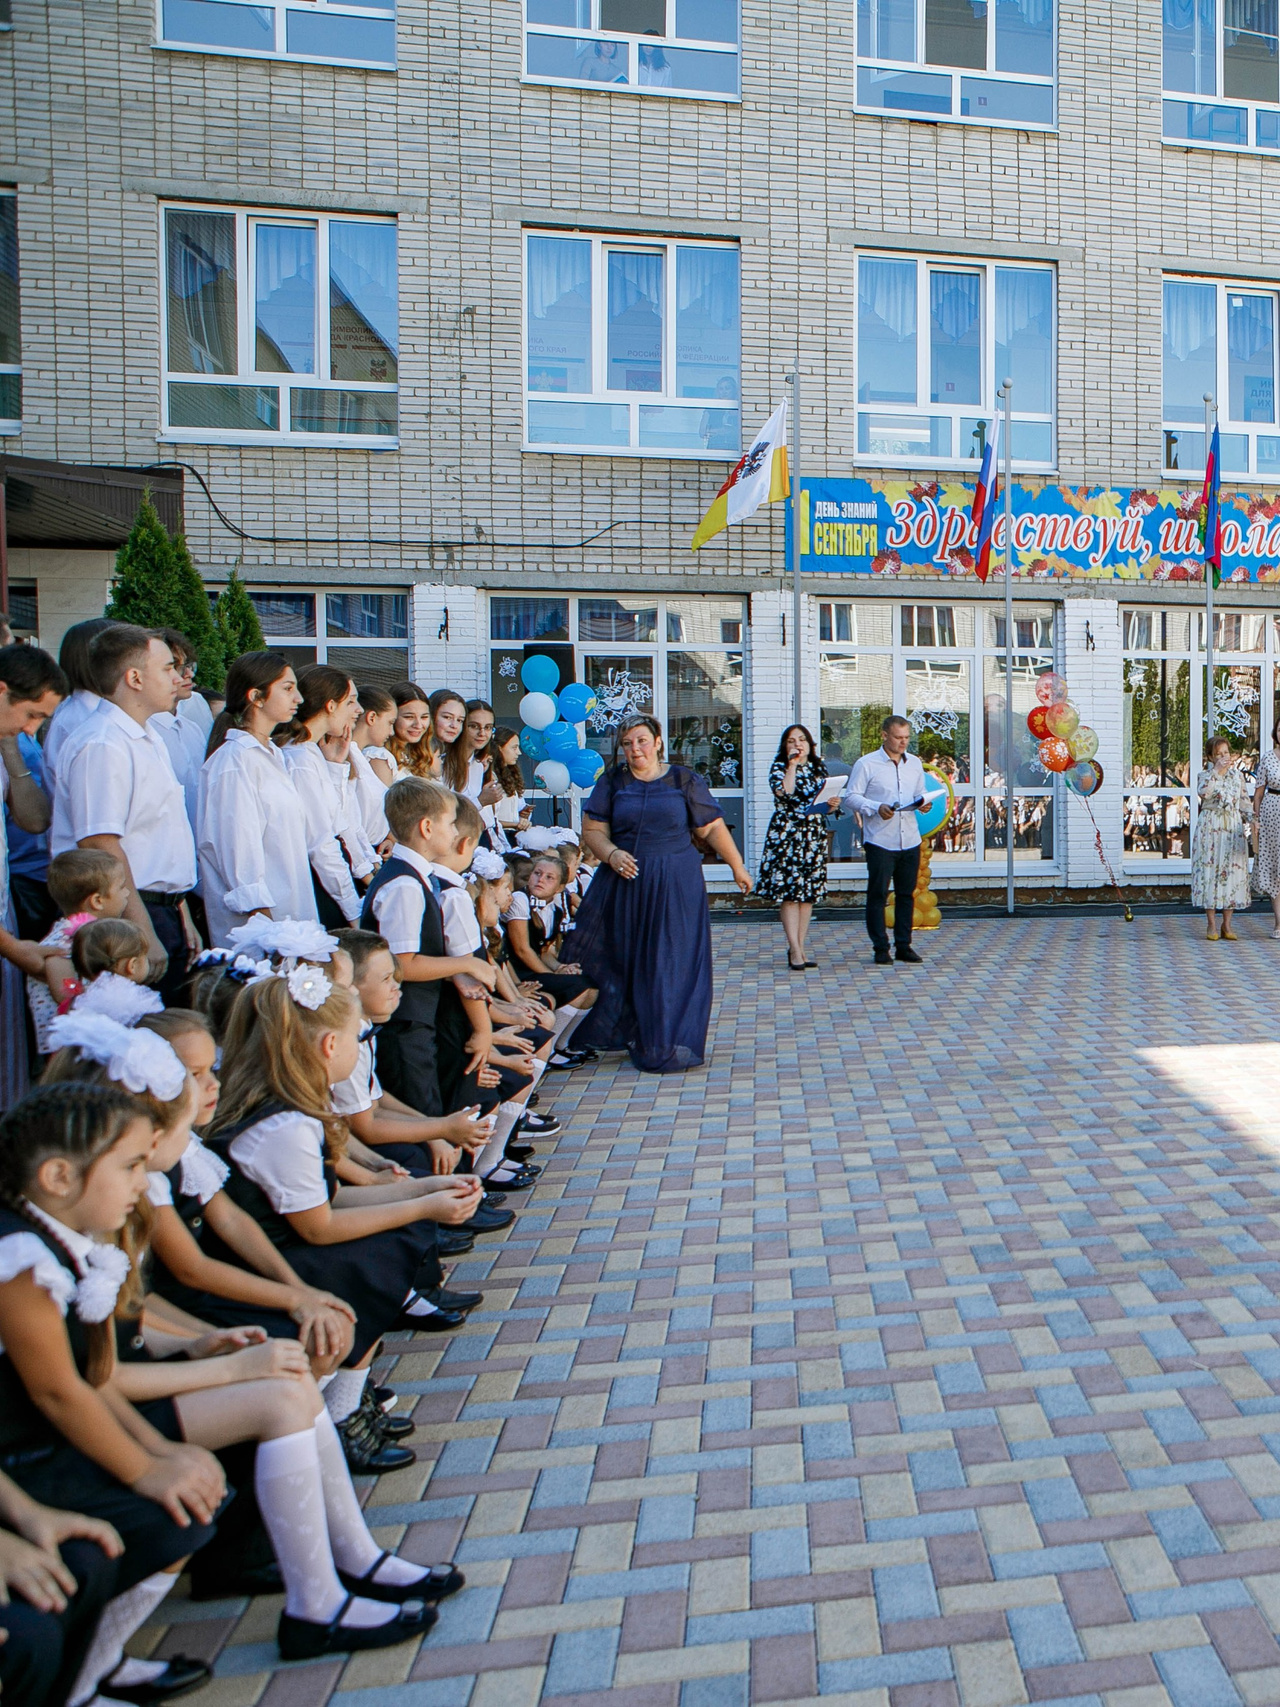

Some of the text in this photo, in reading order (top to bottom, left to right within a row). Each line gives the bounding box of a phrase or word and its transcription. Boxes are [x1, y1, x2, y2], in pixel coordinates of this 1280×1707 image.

[1250, 389, 1272, 398] ДЛЯ
[1257, 399, 1271, 408] ИХ
[815, 500, 878, 520] ДЕНЬ ЗНАНИЙ
[813, 521, 878, 557] СЕНТЯБРЯ
